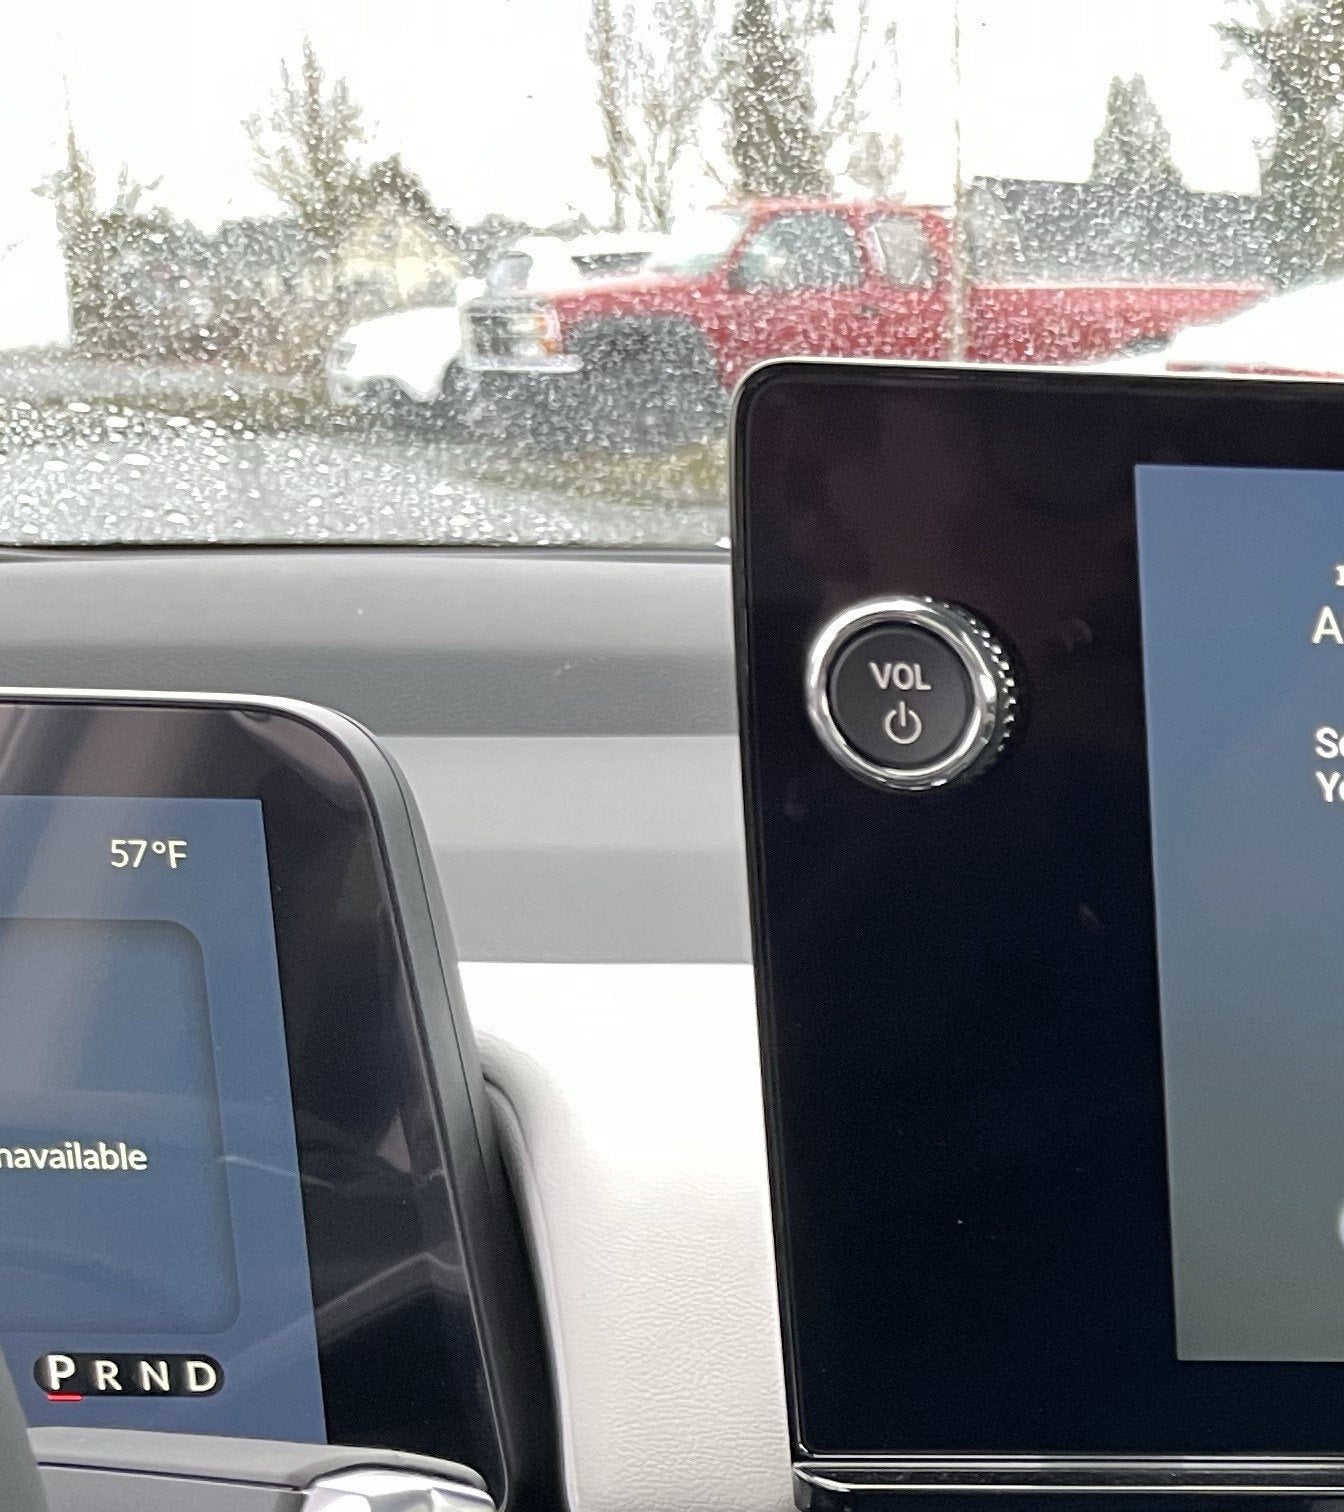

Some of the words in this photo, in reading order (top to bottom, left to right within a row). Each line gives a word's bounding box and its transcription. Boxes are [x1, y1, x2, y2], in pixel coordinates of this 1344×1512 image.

[868, 662, 932, 691] VOL
[111, 839, 187, 869] 57°F
[46, 1354, 76, 1391] P
[94, 1360, 123, 1391] R
[140, 1360, 170, 1392] N
[186, 1360, 217, 1392] D
